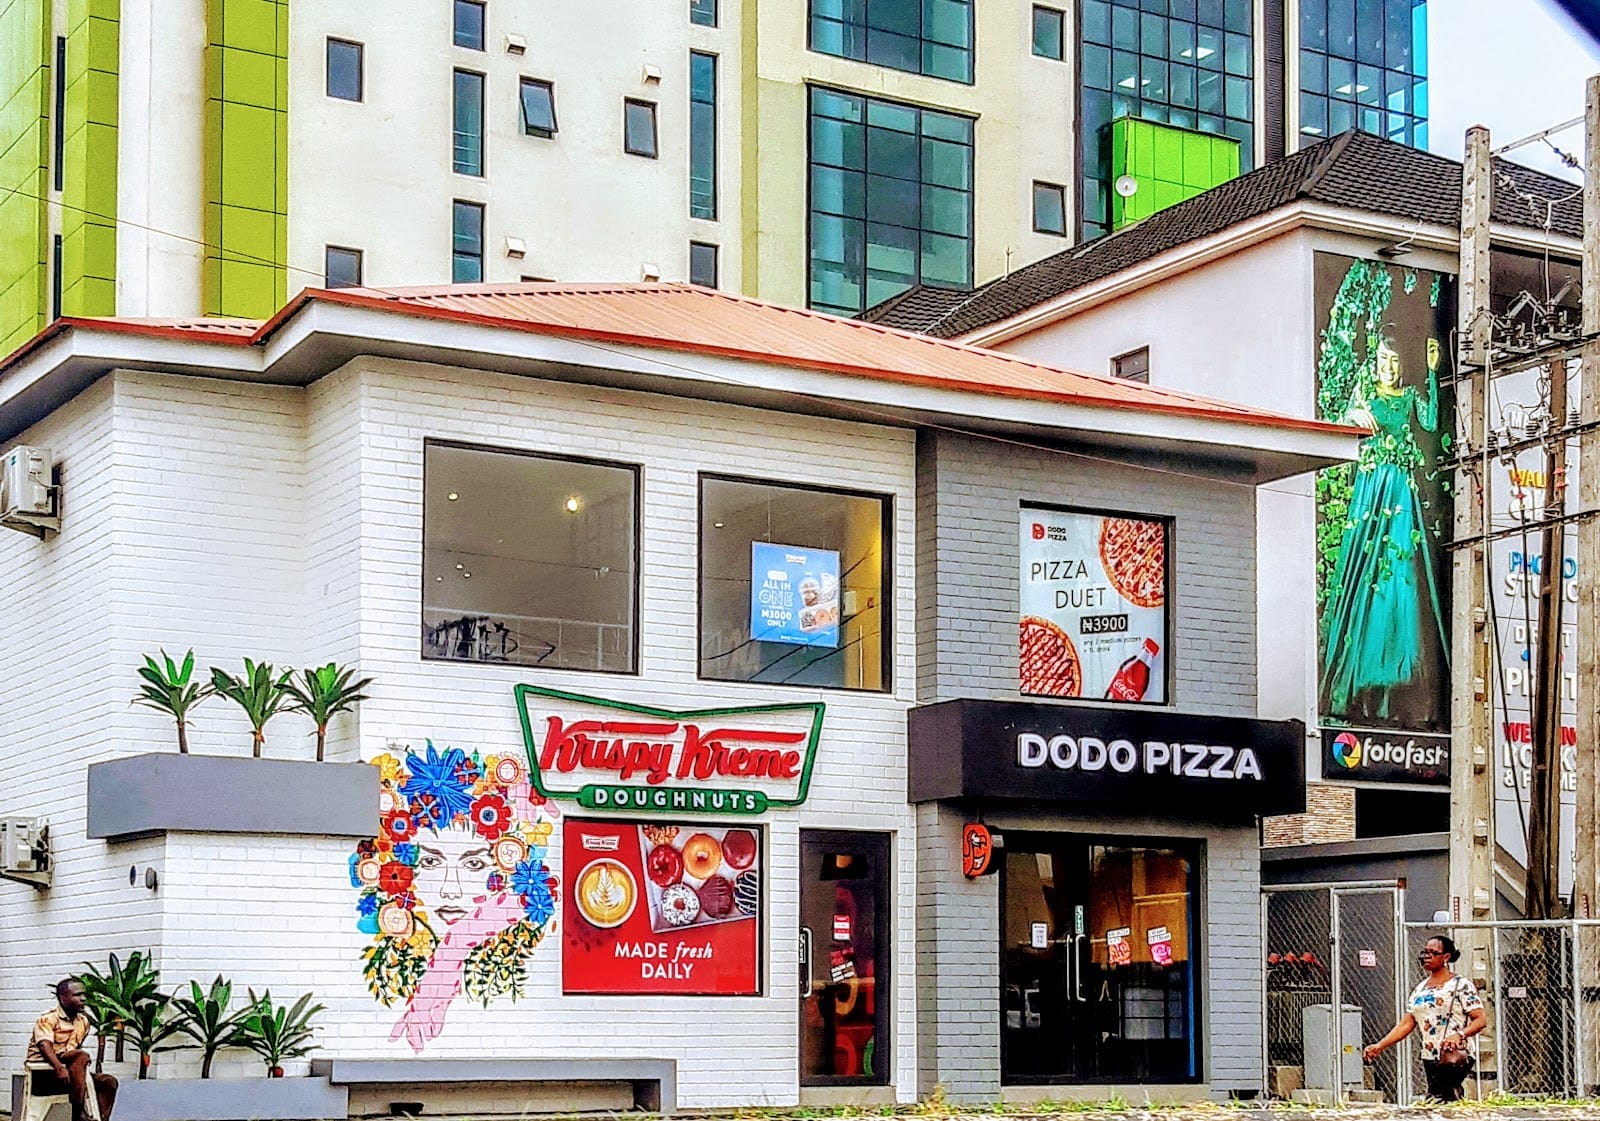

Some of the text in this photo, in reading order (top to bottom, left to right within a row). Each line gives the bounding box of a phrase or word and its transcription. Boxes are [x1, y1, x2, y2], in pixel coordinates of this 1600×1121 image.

[1031, 559, 1089, 581] PIZZA
[763, 580, 791, 590] ALL IN
[758, 588, 794, 607] ONE
[1055, 587, 1107, 609] DUET
[540, 716, 807, 785] Krispy Kreme
[1017, 733, 1263, 780] DODO PIZZA
[594, 788, 756, 810] DOUGHNUTS
[615, 941, 713, 963] MADE fresh
[642, 963, 693, 979] DAILY
